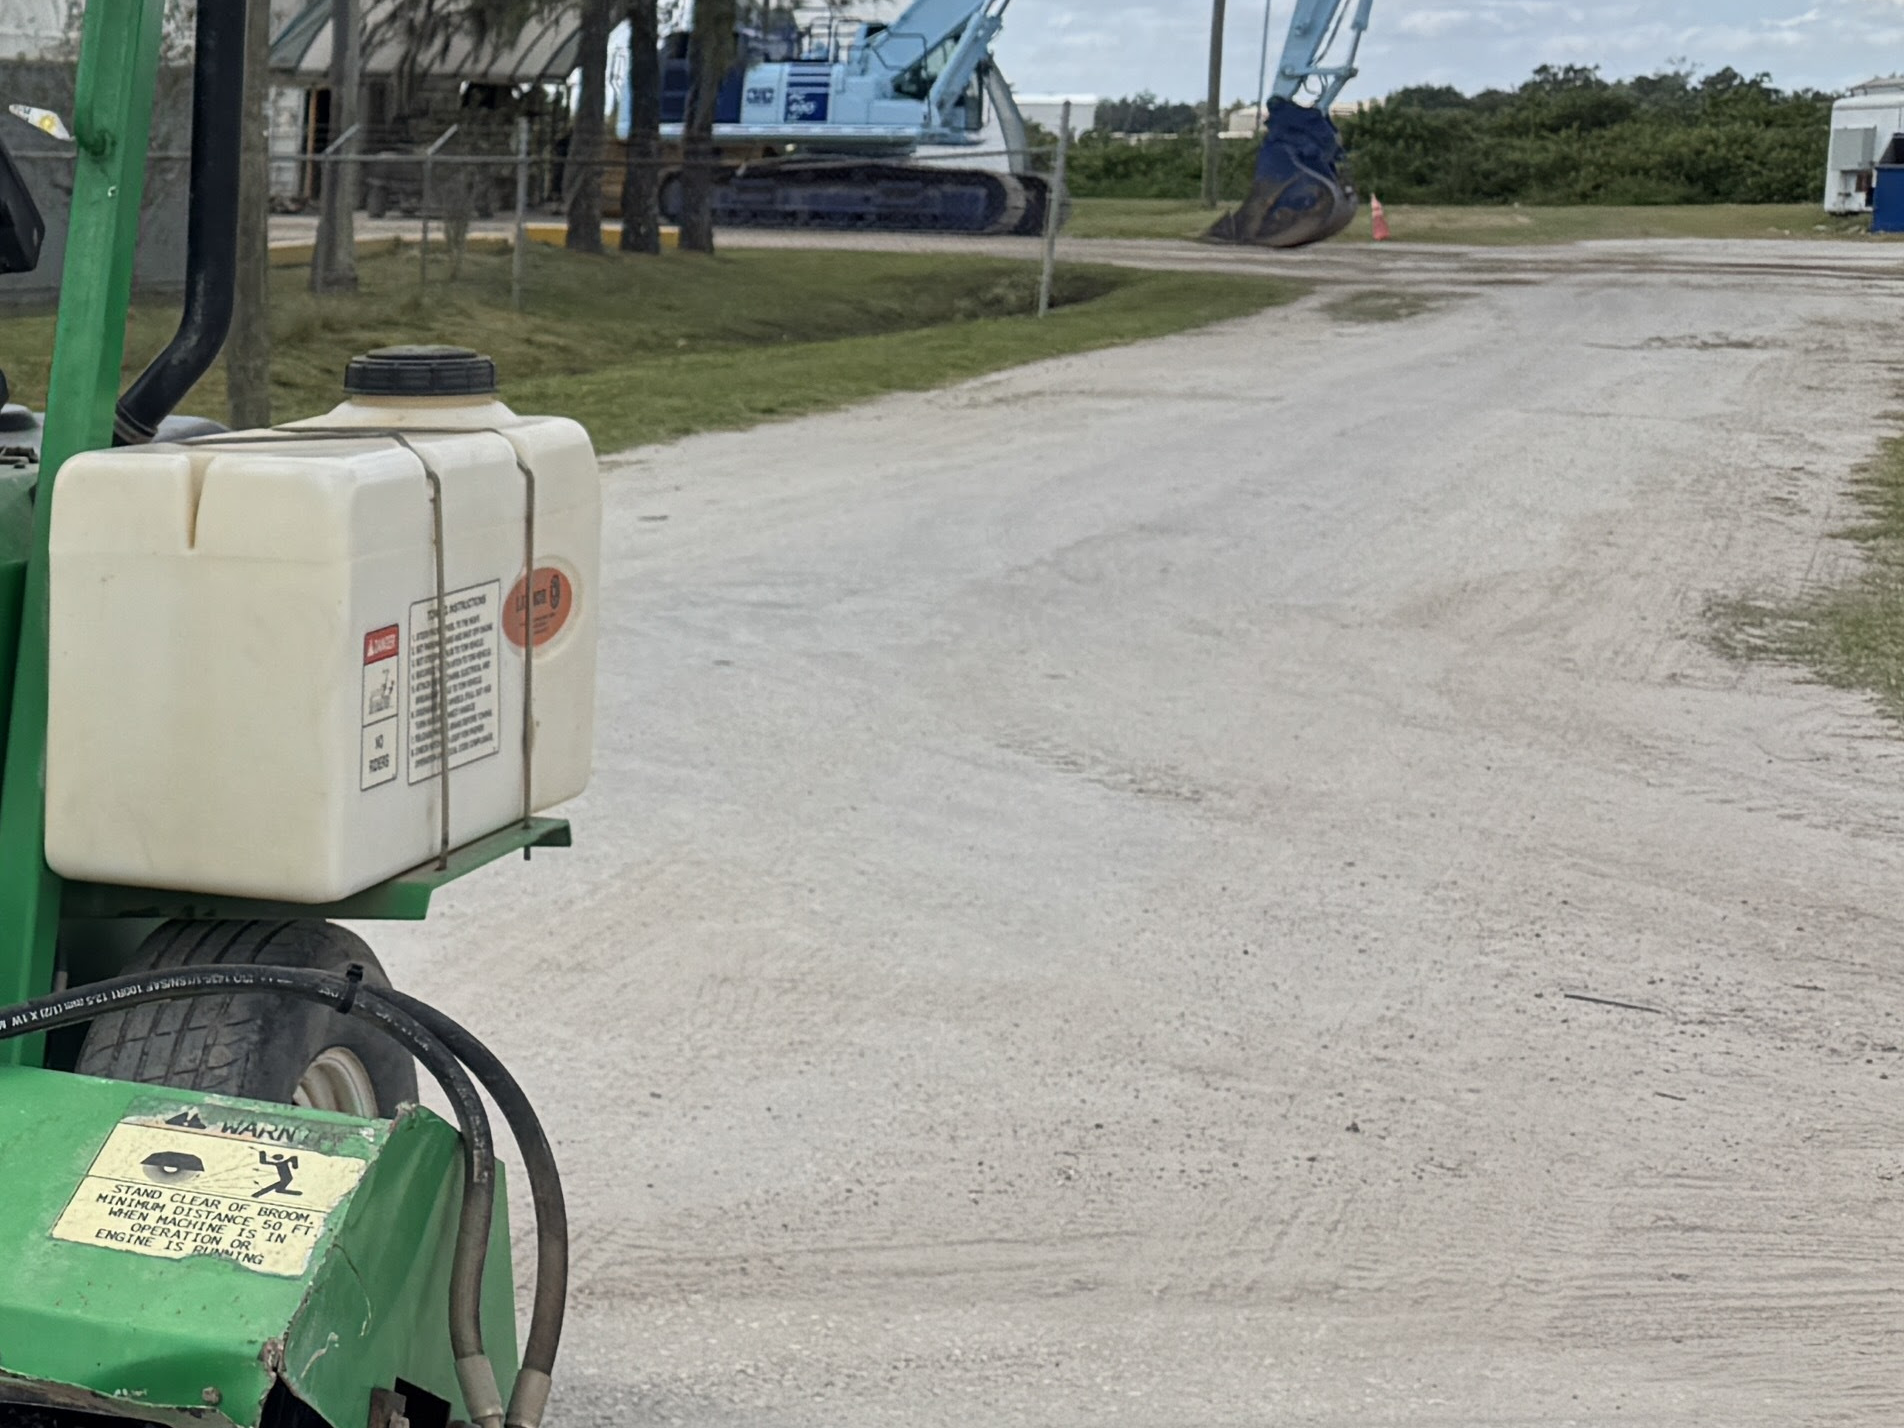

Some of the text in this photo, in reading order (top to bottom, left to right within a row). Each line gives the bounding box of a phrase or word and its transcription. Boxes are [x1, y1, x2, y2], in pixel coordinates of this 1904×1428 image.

[95, 1193, 166, 1213] MINIMUM
[172, 1205, 254, 1227] DISTANCE
[261, 1220, 283, 1231] 50
[112, 1184, 314, 1225] STAND CLEAR OF BROOM.
[95, 1228, 156, 1247] ENGINE
[163, 1240, 185, 1252] IS
[108, 1207, 287, 1244] WHEN MACHINE IS IN
[130, 1223, 252, 1251] OPERATION OR
